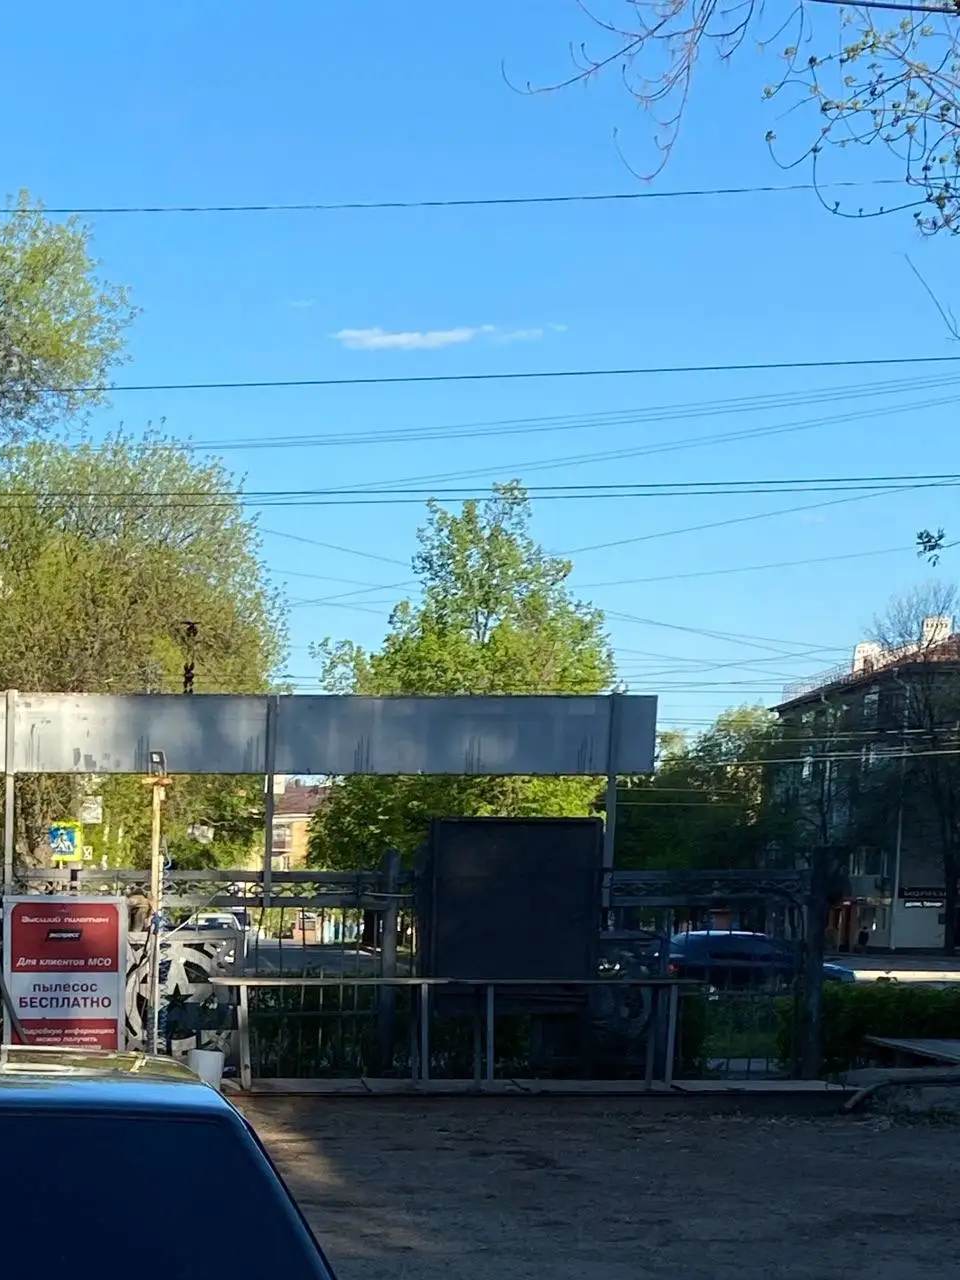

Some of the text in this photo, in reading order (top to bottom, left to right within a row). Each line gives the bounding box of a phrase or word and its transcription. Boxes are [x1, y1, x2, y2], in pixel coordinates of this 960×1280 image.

[16, 957, 37, 967] Для
[88, 958, 112, 966] МСО
[33, 983, 98, 993] пылесос
[19, 997, 112, 1009] БЕСПЛАТНО
